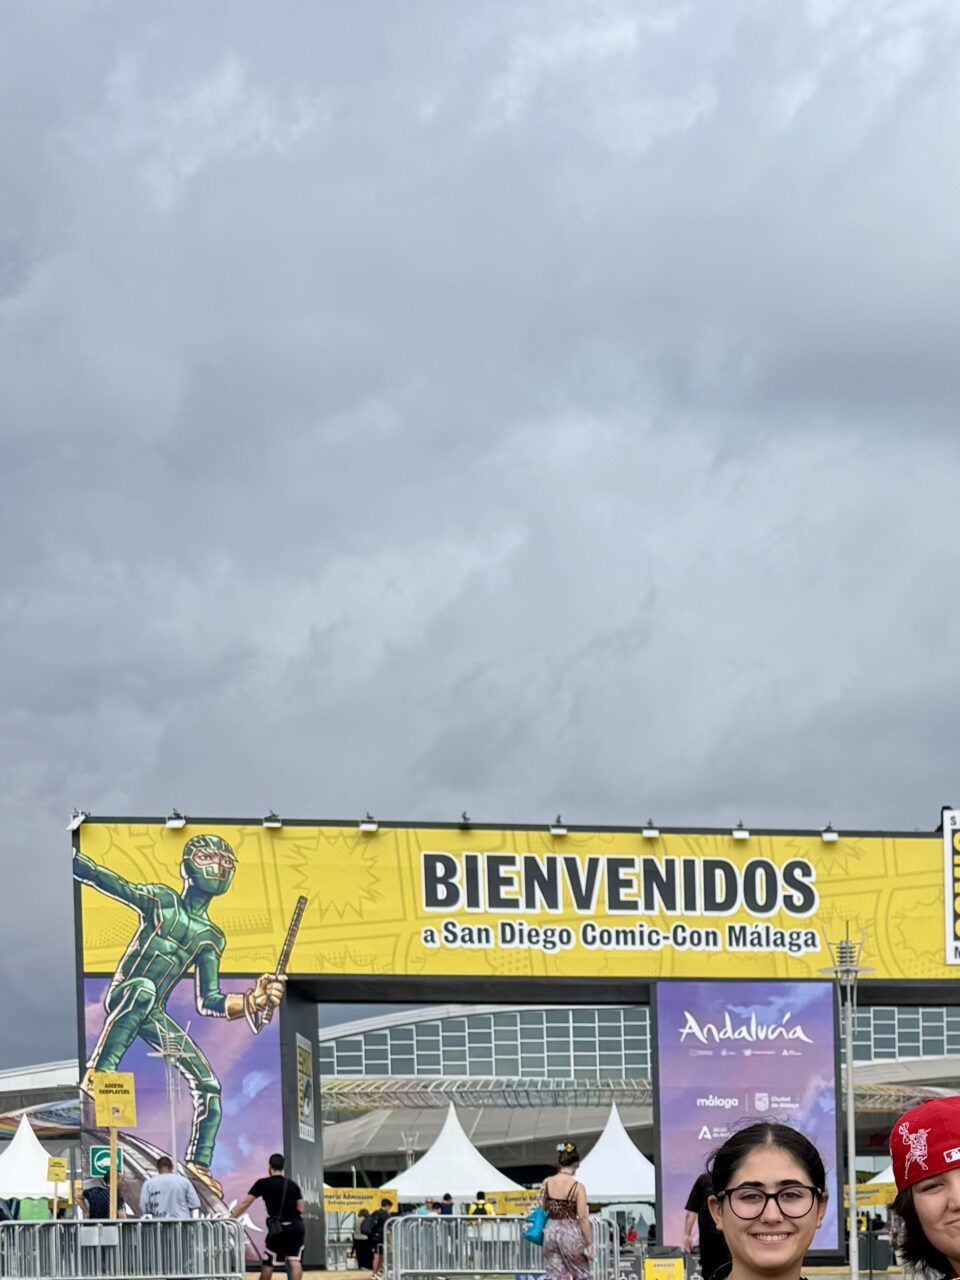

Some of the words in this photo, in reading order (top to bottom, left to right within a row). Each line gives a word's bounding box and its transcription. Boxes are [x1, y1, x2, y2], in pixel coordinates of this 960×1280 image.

[422, 853, 816, 914] BIENVENIDOS
[423, 928, 436, 944] a
[443, 921, 491, 944] San
[500, 922, 572, 950] Diego
[582, 922, 719, 947] Comic-Con
[727, 924, 817, 952] Málaga
[678, 1010, 814, 1044] Andalucía
